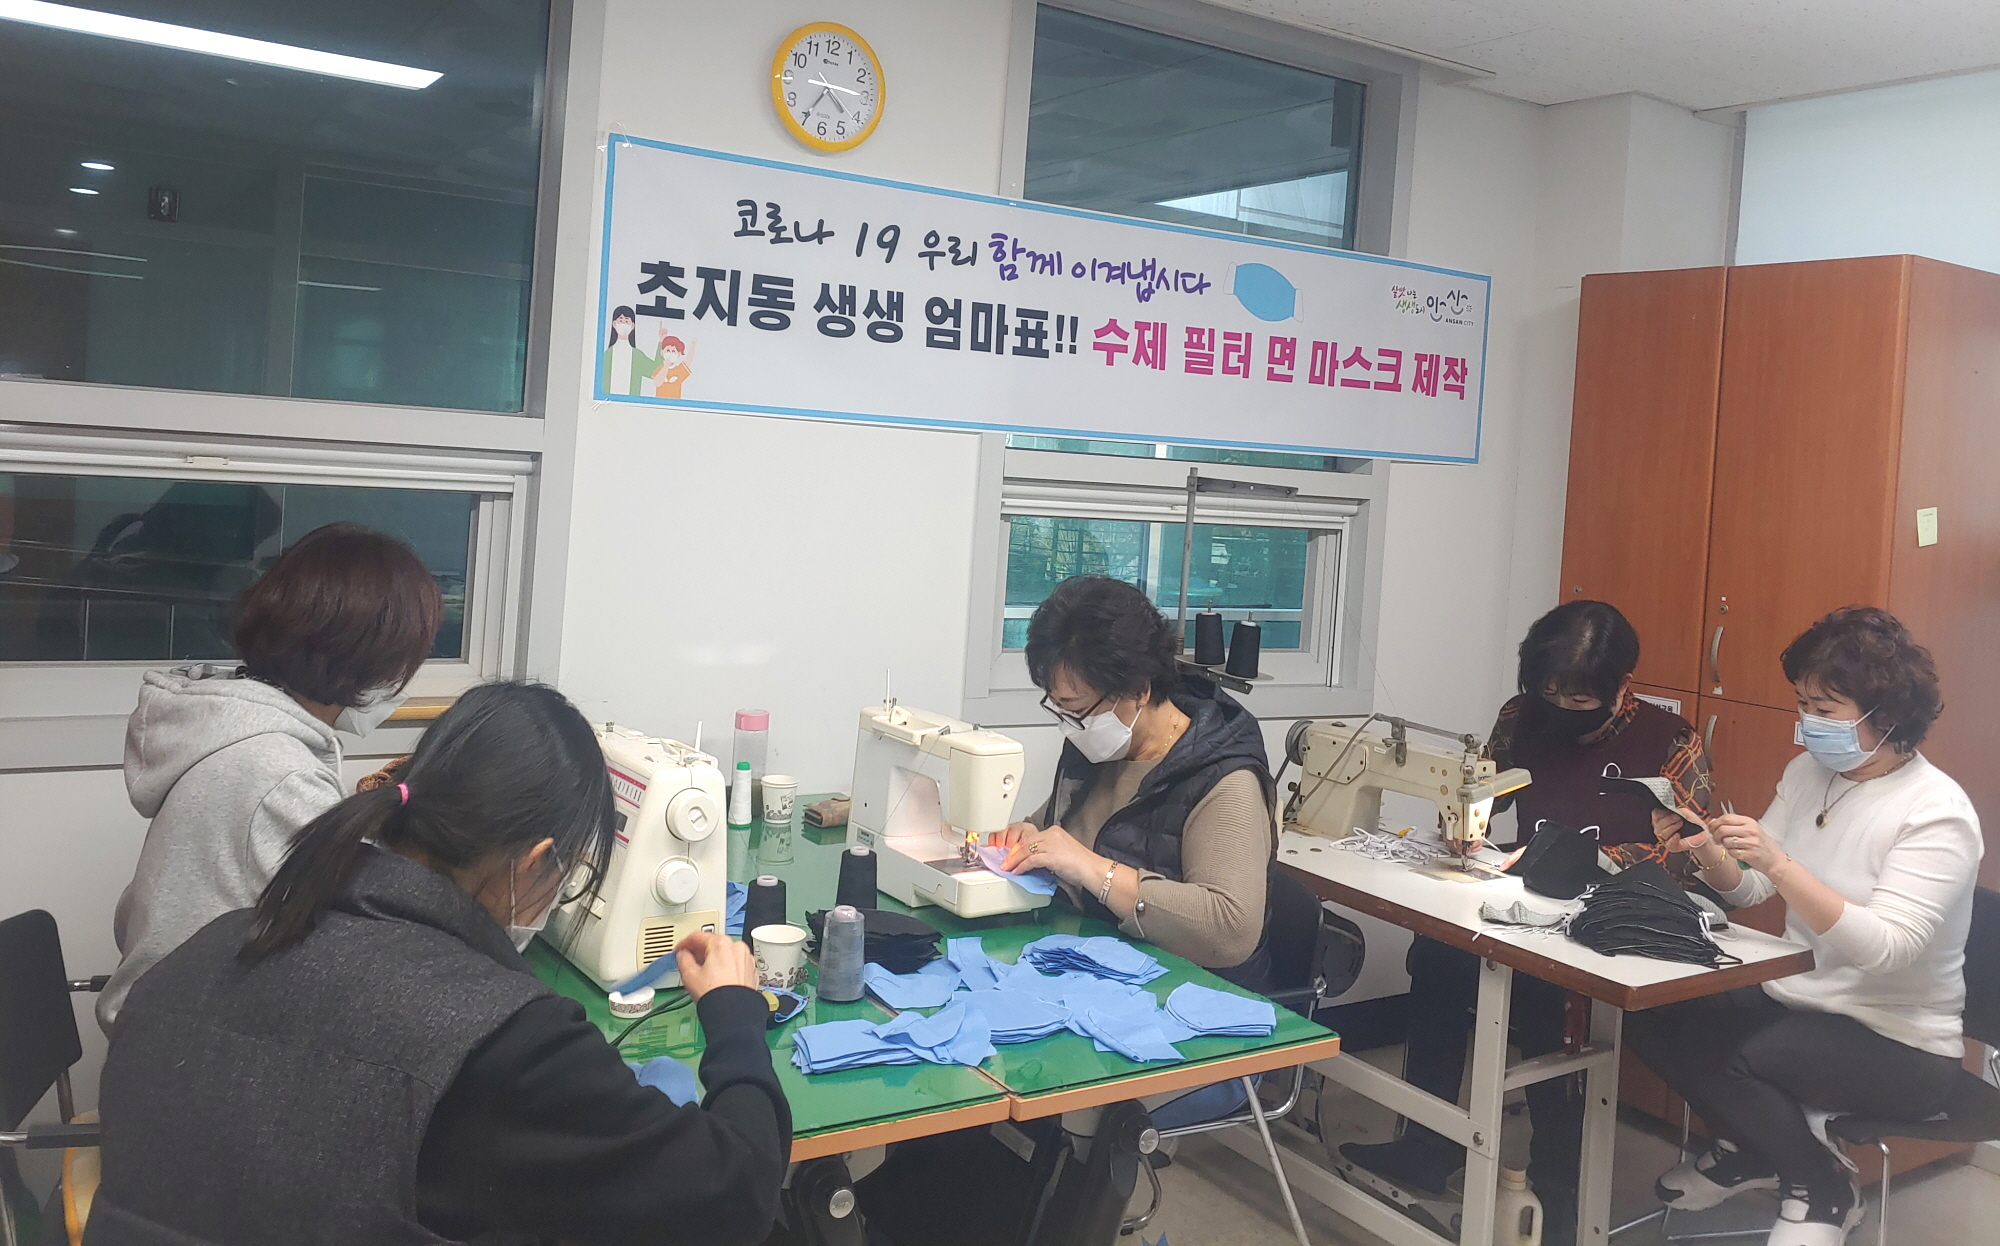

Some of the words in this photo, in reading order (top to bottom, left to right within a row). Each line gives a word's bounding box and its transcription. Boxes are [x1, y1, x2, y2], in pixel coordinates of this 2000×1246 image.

[807, 40, 819, 57] 11
[825, 39, 841, 56] 12
[792, 52, 807, 69] 10
[847, 50, 853, 65] 1
[856, 67, 867, 84] 2
[786, 91, 797, 107] 8
[860, 90, 869, 106] 3
[802, 110, 811, 126] 7
[852, 110, 861, 124] 4
[816, 121, 827, 136] 6
[836, 120, 846, 136] 5
[734, 199, 835, 245] 코로나
[856, 222, 900, 263] 19
[918, 230, 977, 270] 우리
[989, 233, 1063, 281] 함께
[1071, 258, 1211, 303] 이겨냅시다
[635, 261, 796, 331] 초지동
[813, 282, 904, 343] 생생
[925, 296, 1079, 358] 엄마표!!
[1092, 318, 1168, 371] 수제
[1183, 326, 1252, 379] 필터
[1266, 336, 1297, 383] 면
[1308, 341, 1402, 392] 마스크
[1411, 353, 1468, 400] 제작
